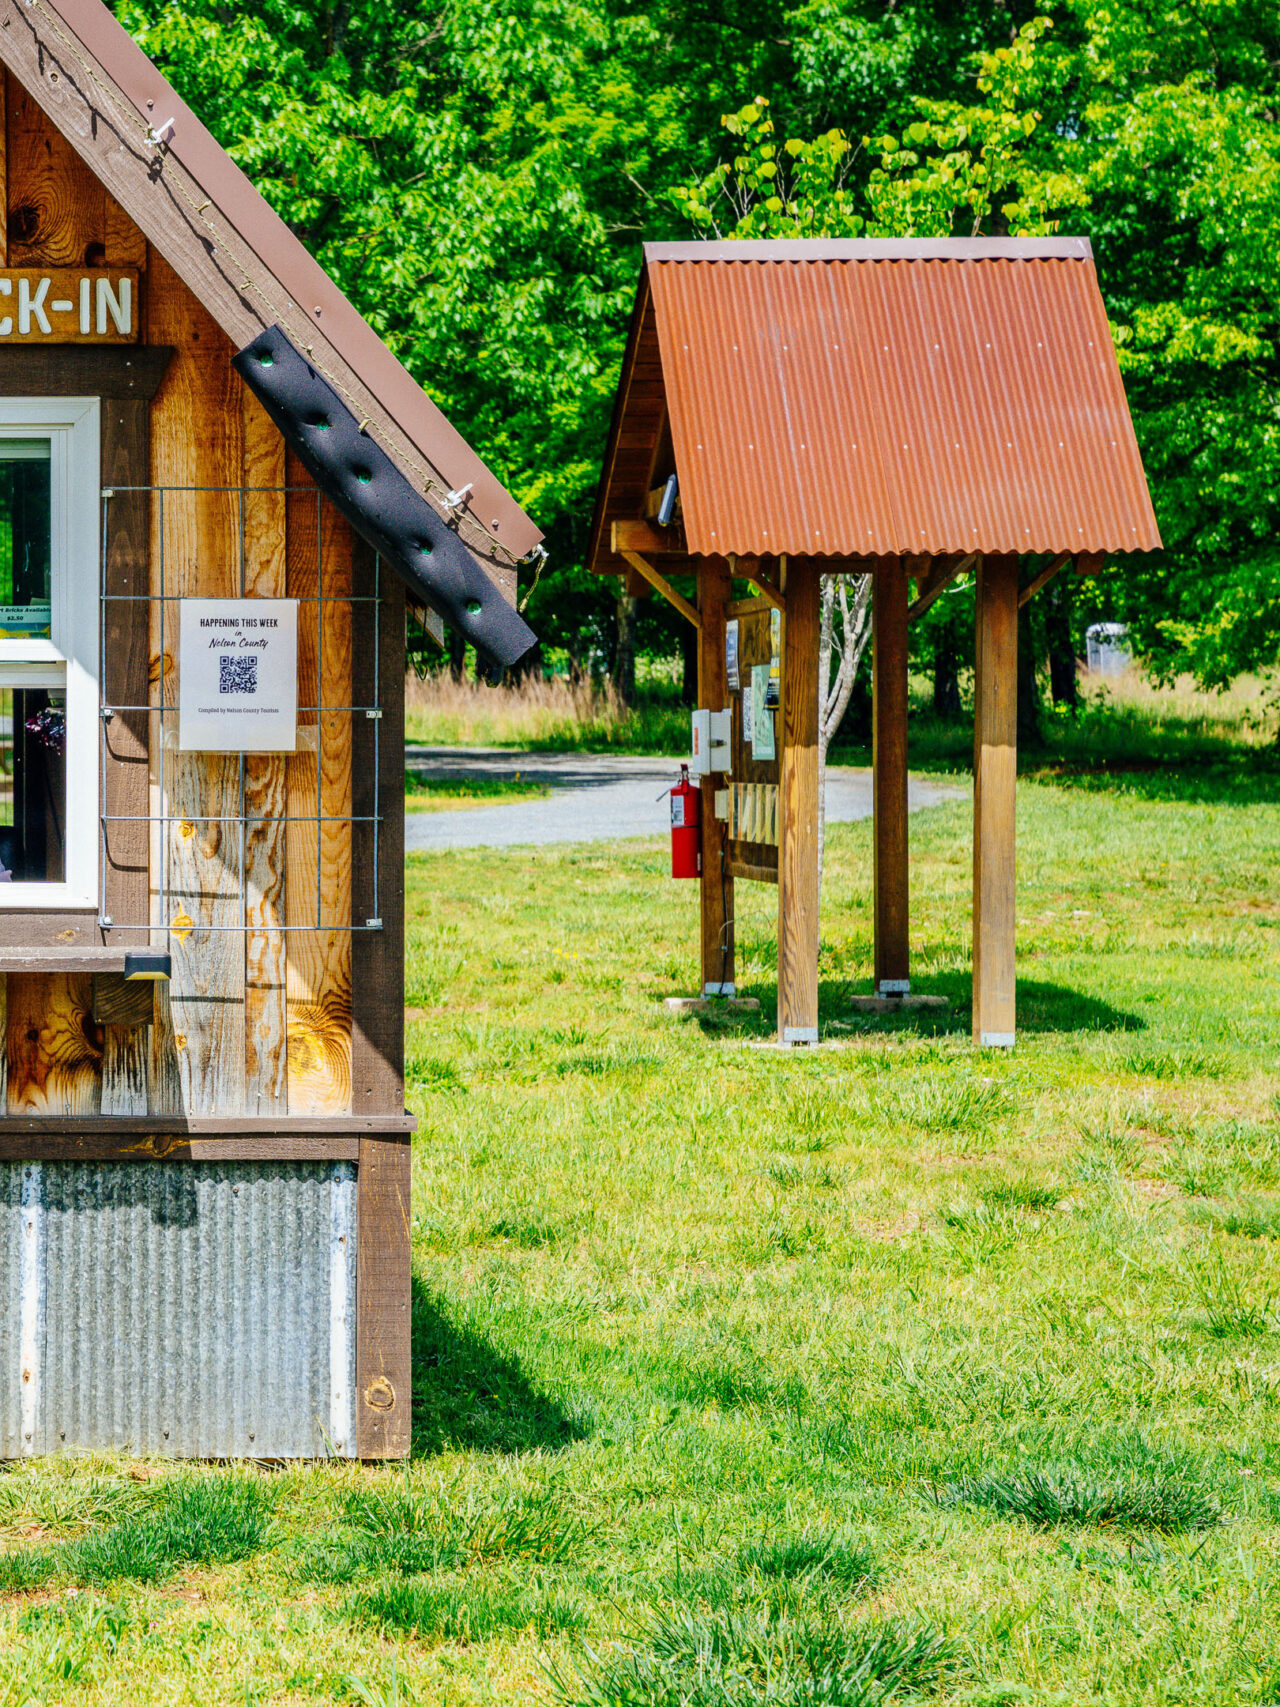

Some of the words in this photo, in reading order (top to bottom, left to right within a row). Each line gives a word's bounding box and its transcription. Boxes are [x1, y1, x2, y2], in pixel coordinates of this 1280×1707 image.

[200, 618, 240, 628] HAPPENING
[241, 618, 258, 628] THIS
[259, 618, 279, 628] WEEK
[208, 638, 237, 649] Nelson
[238, 638, 269, 650] County
